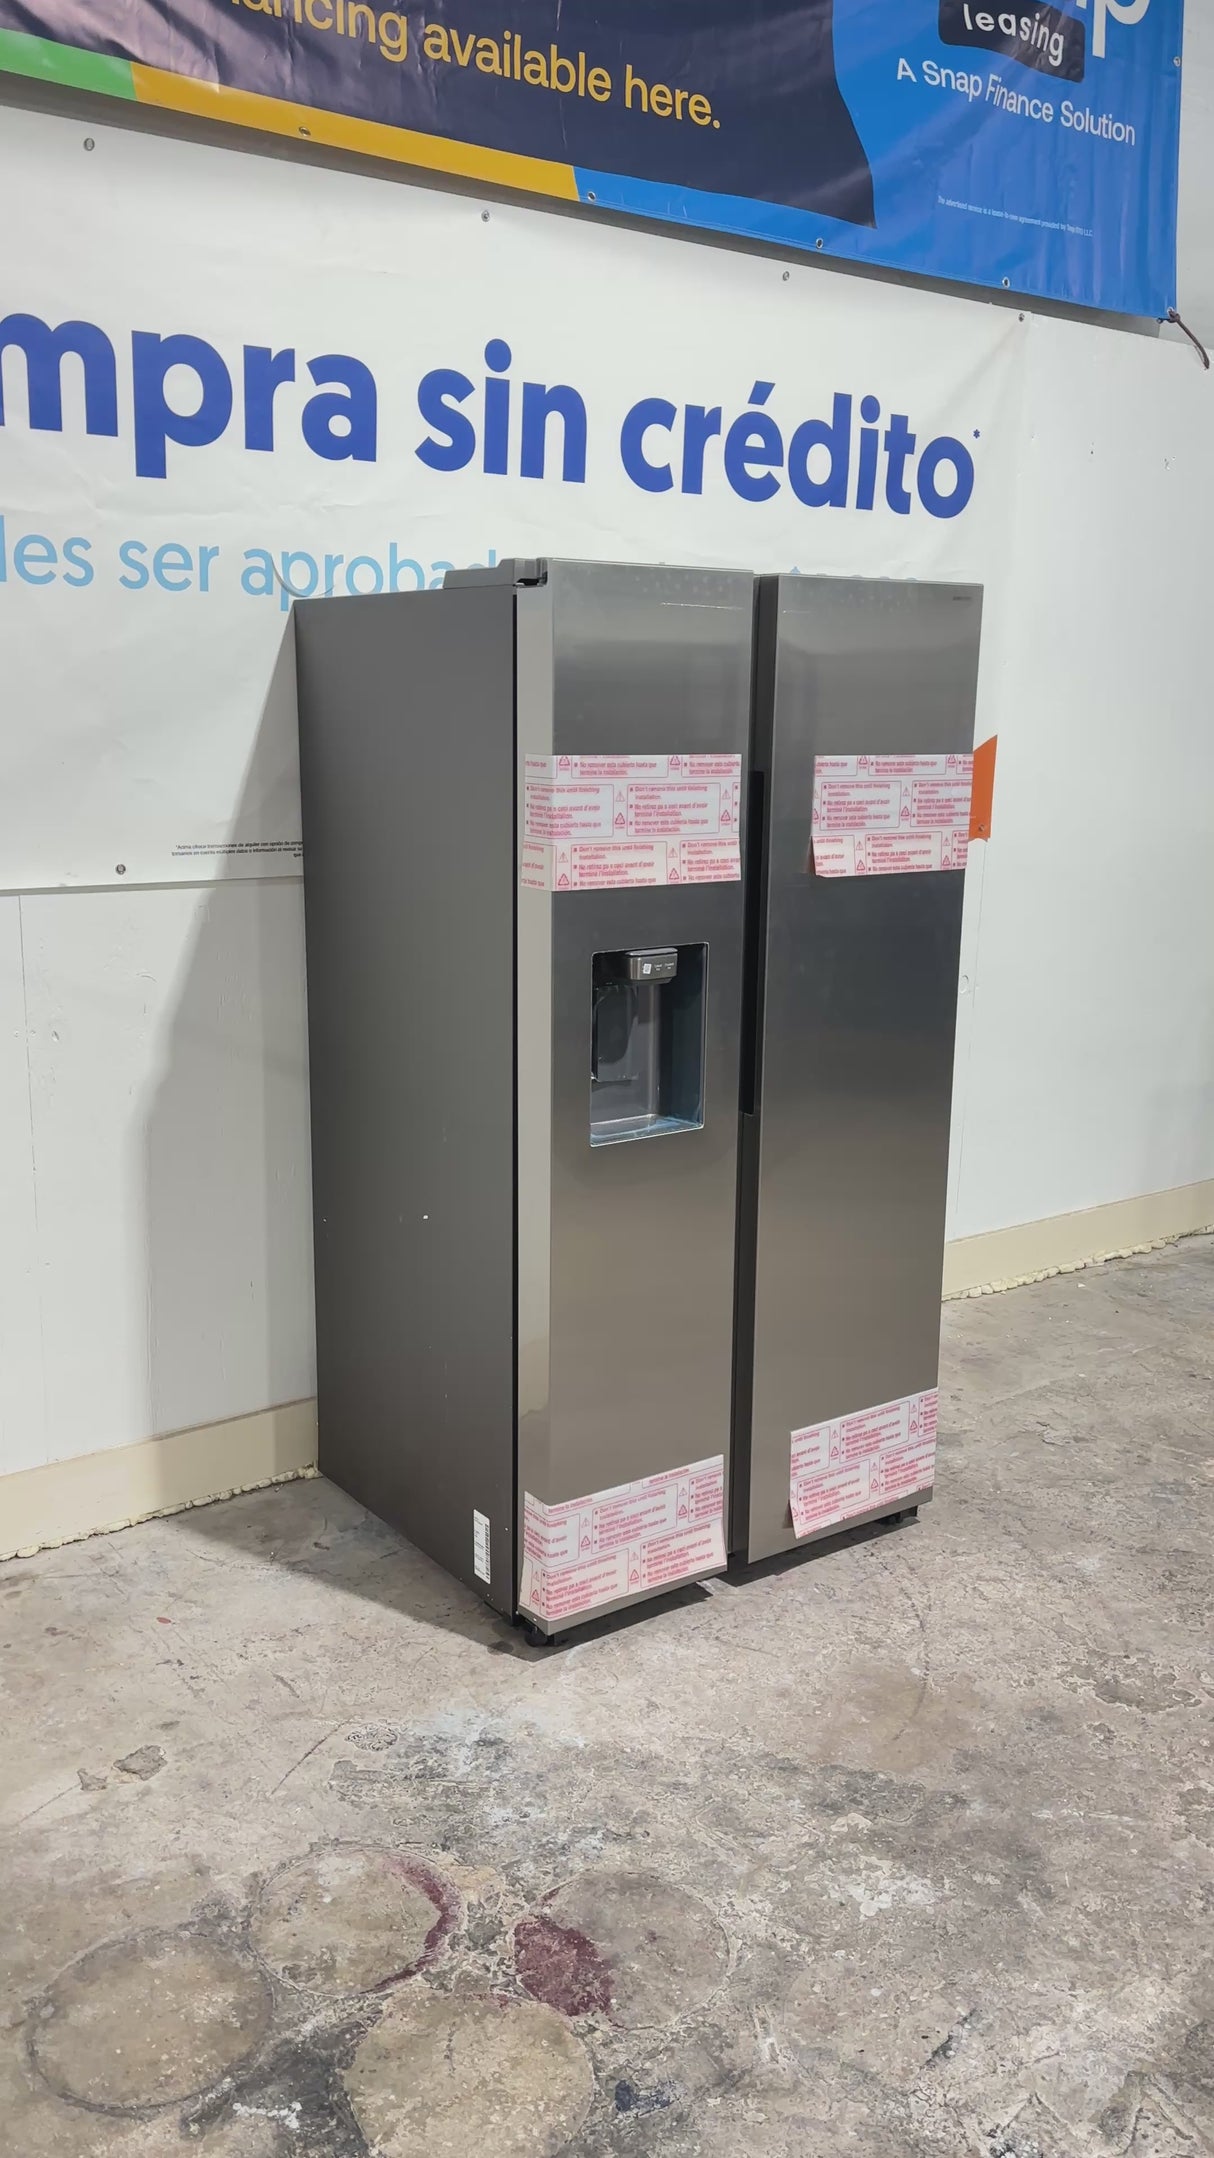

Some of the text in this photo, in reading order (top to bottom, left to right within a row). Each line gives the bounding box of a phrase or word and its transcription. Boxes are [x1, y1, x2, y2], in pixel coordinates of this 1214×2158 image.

[963, 3, 1064, 67] leasing
[423, 30, 612, 103] available
[625, 64, 721, 129] here.
[897, 58, 1136, 146] A Snap Finance Solution
[0, 313, 377, 479] mpra
[415, 338, 588, 483] sin
[0, 515, 94, 587] es
[119, 540, 220, 592] ser
